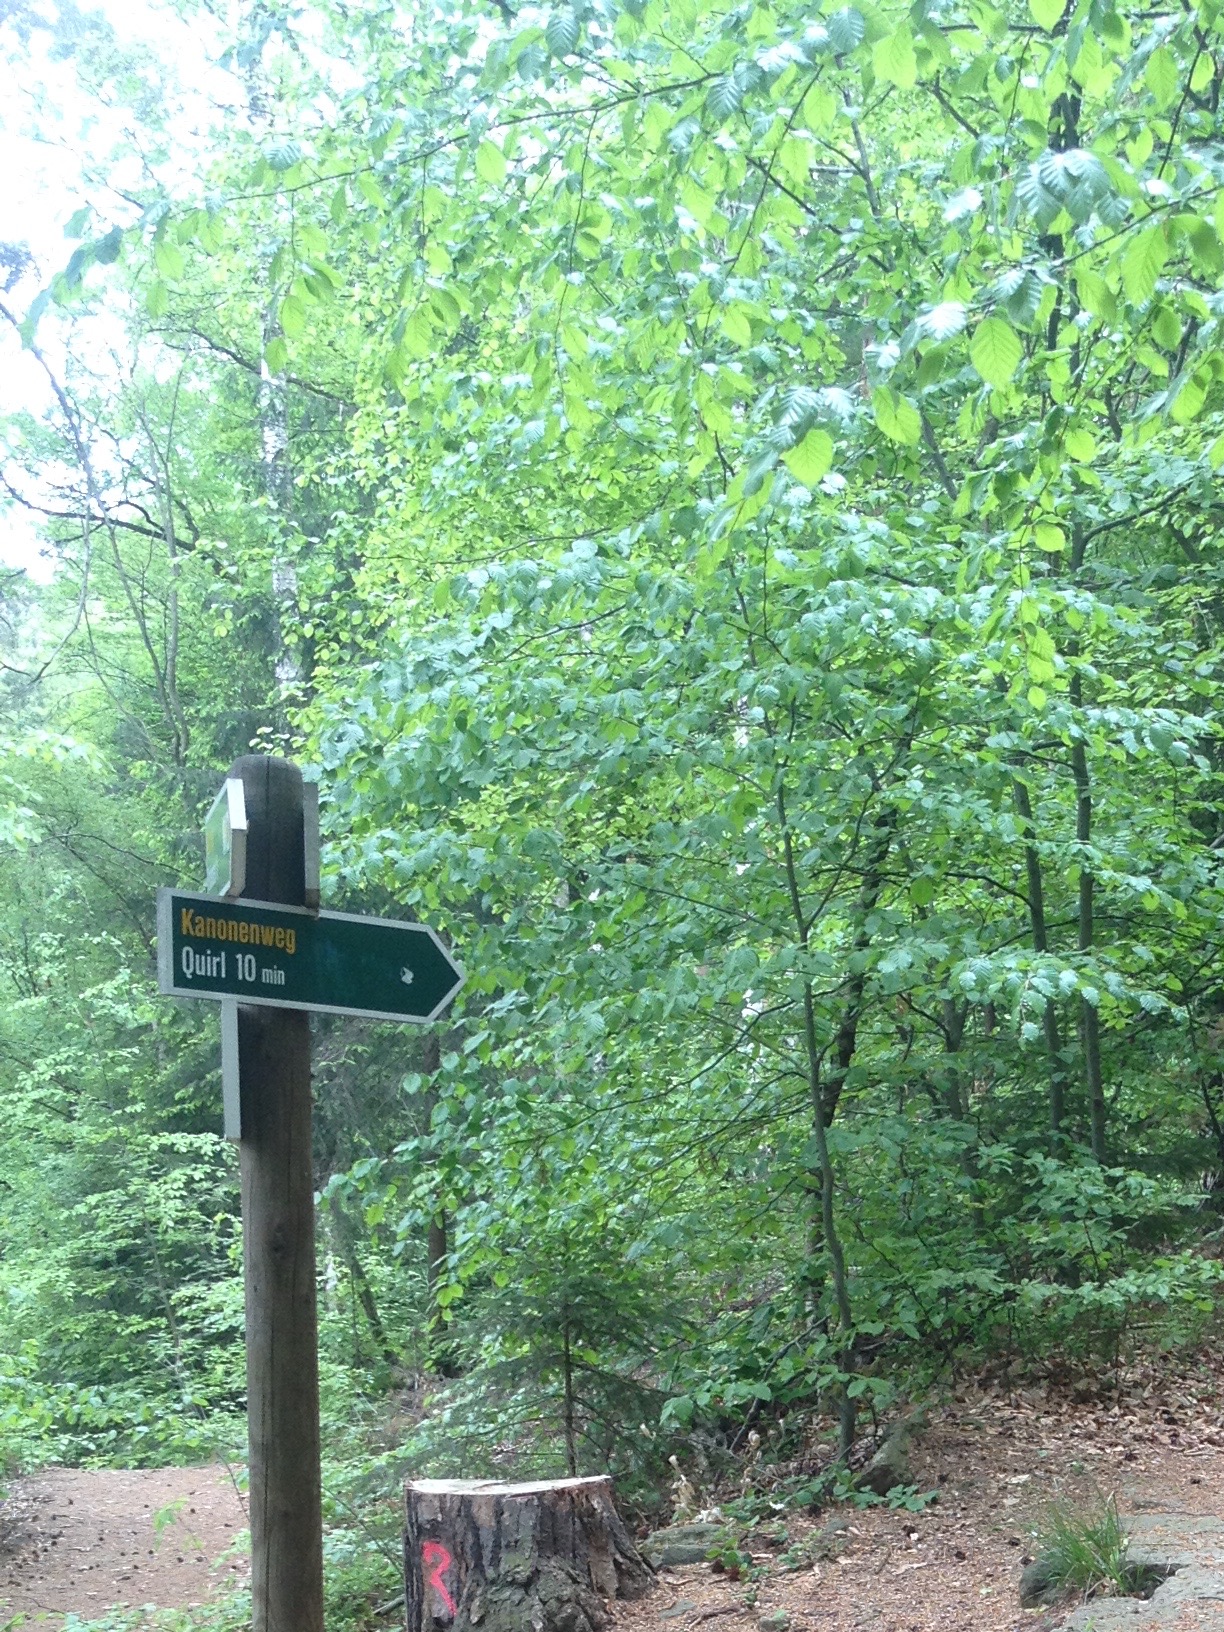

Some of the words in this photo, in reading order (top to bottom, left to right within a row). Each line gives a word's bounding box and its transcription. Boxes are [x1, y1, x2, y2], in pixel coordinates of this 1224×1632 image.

[181, 907, 296, 954] Kanonenweg
[181, 946, 226, 979] Quirl
[235, 953, 257, 982] 10
[261, 965, 286, 985] min
